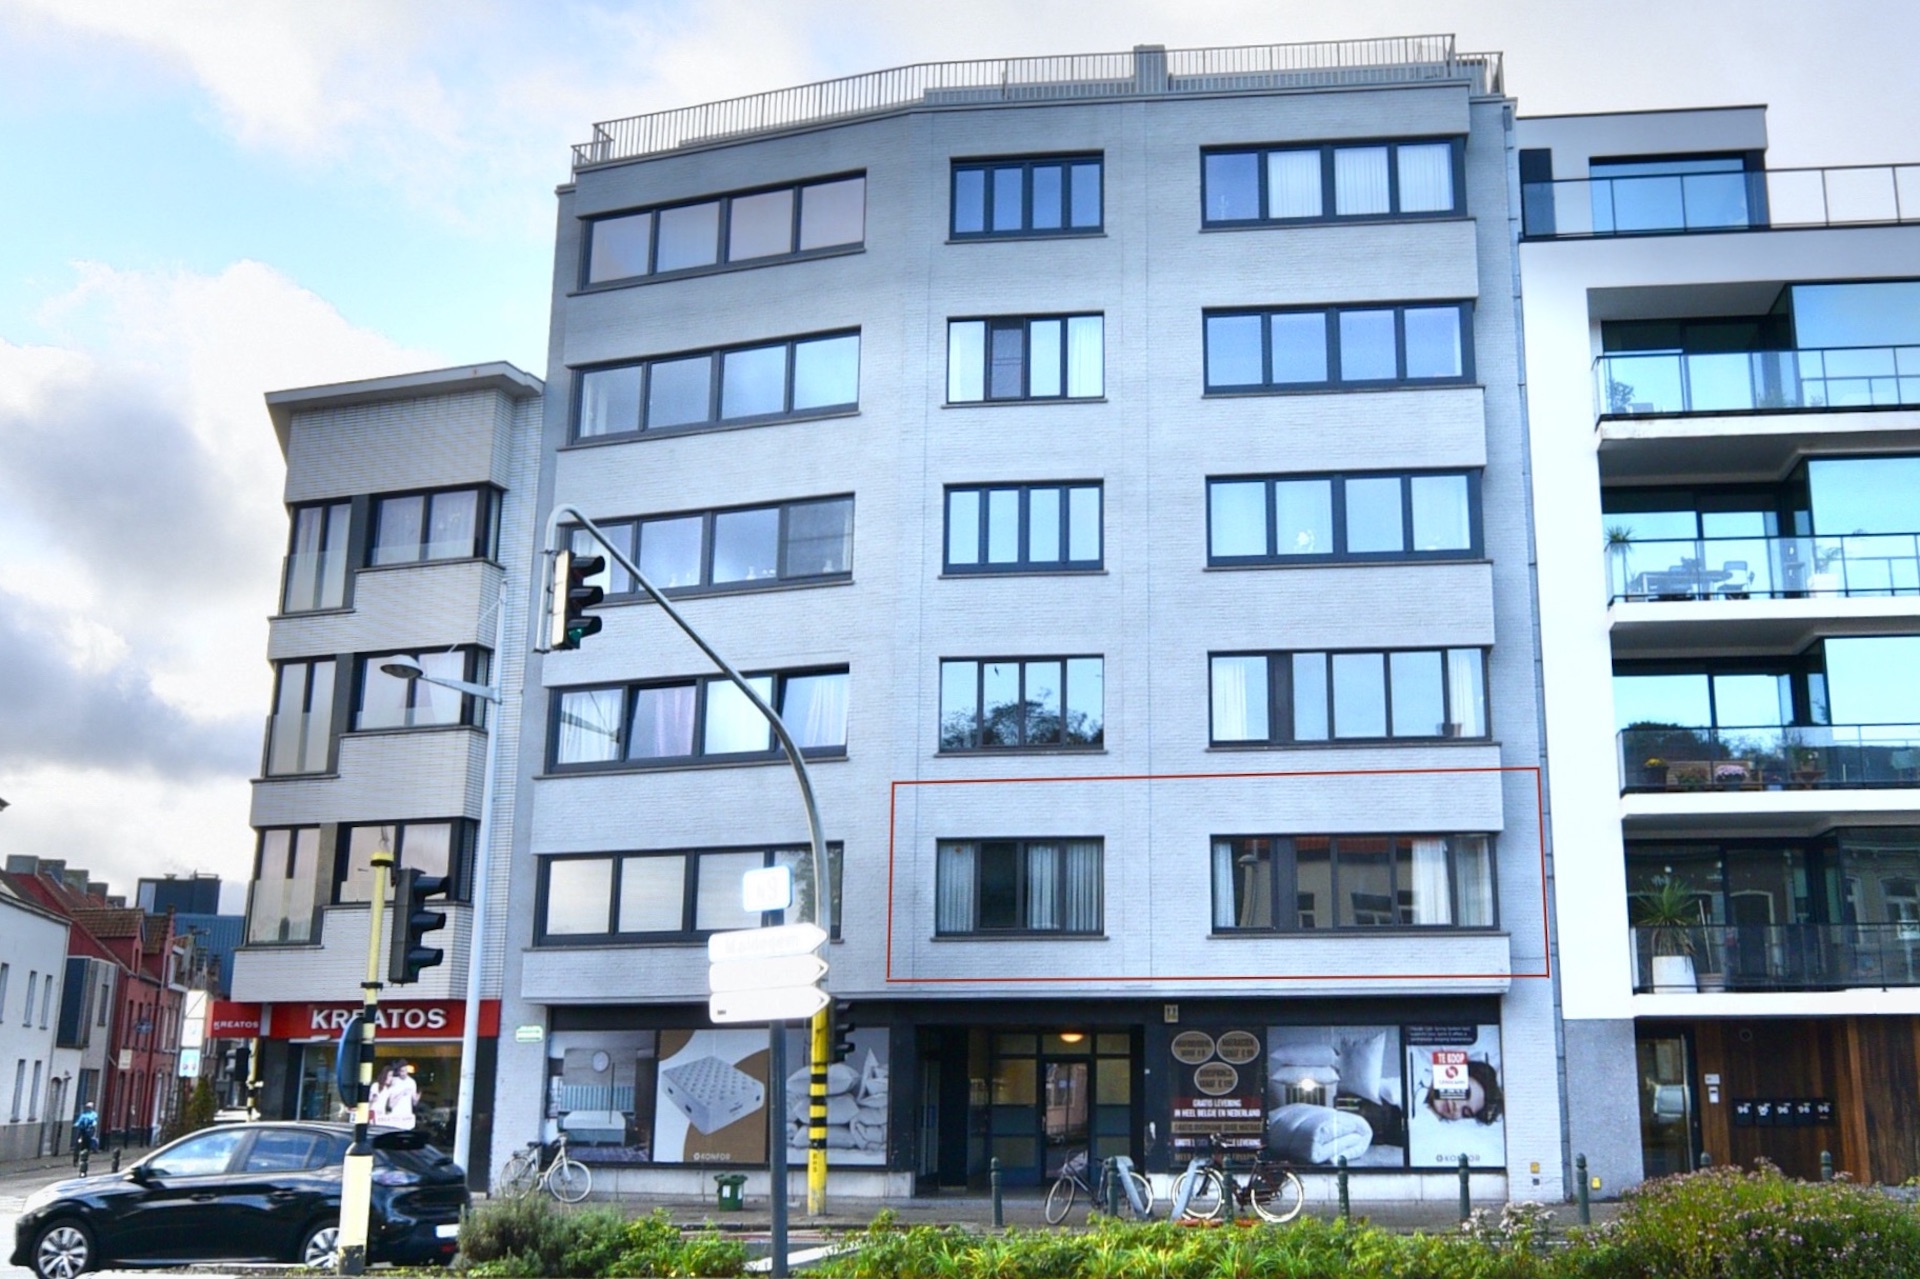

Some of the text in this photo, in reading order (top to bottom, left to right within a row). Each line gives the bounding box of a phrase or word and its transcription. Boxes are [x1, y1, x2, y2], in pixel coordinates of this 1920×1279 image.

[213, 1020, 259, 1030] KREATOS
[1438, 1053, 1465, 1063] TE KOOP
[1192, 1099, 1242, 1107] GRATIS LEVERING
[1174, 1109, 1181, 1117] IN
[1182, 1109, 1196, 1117] HEEL
[1218, 1109, 1226, 1117] EN
[1227, 1109, 1261, 1117] NEDERLAND
